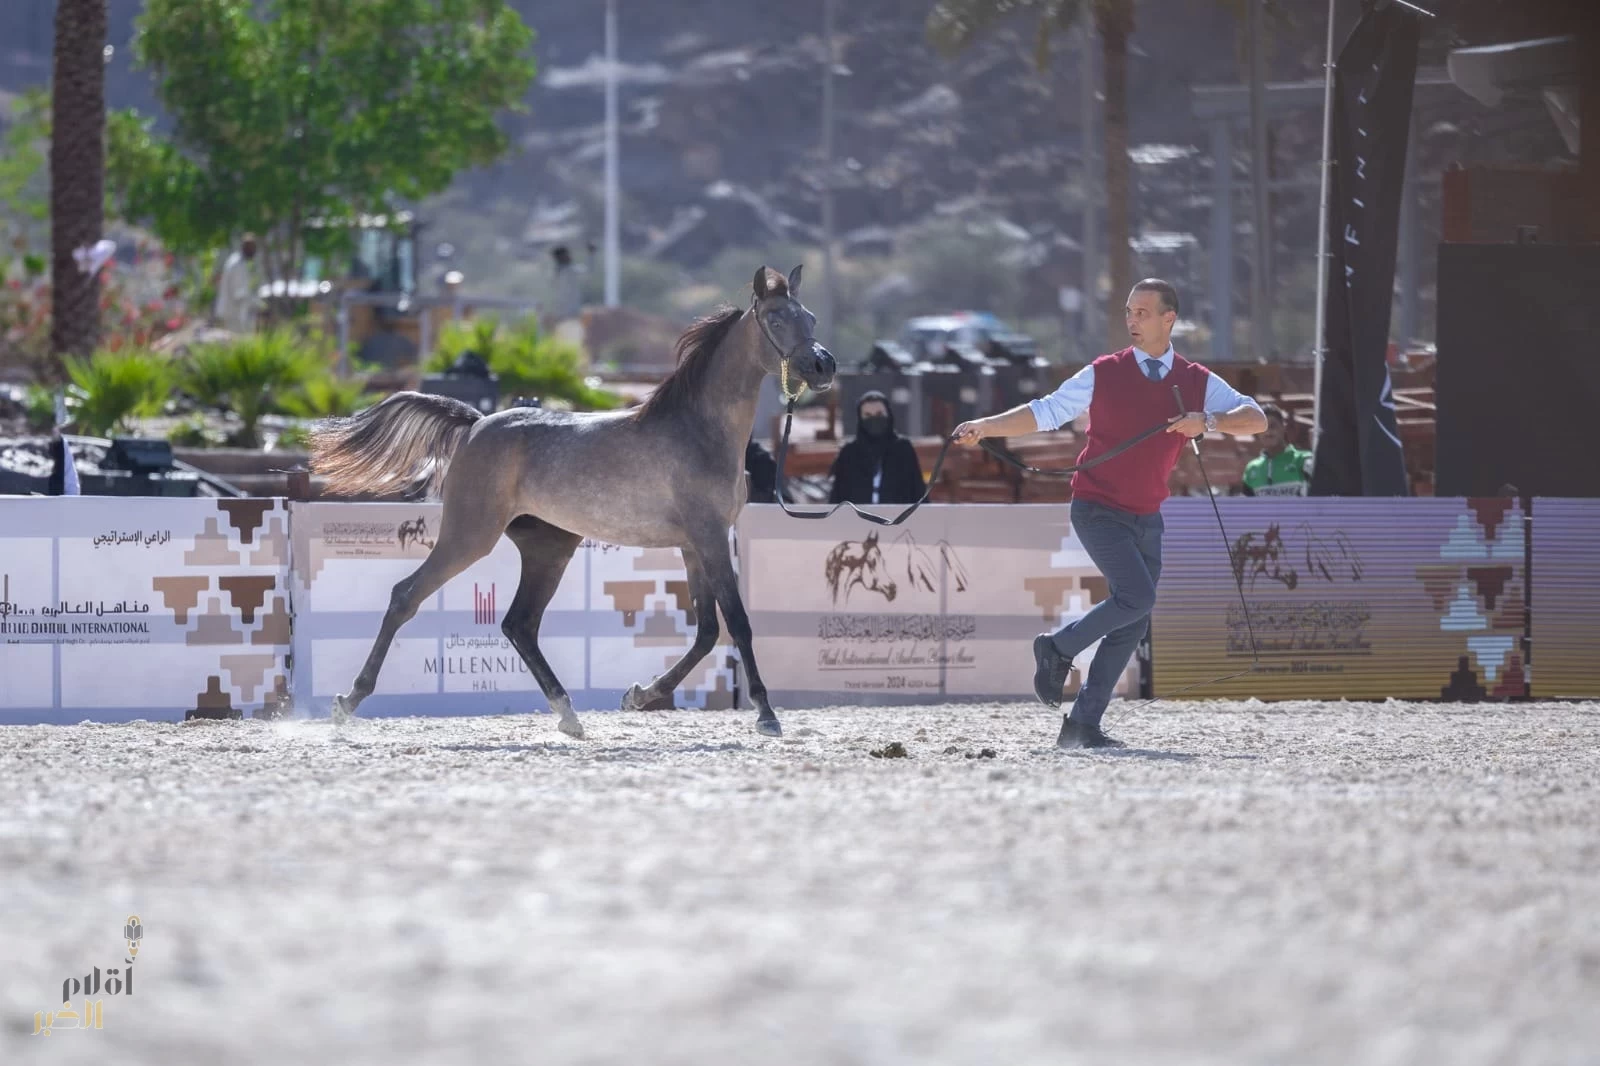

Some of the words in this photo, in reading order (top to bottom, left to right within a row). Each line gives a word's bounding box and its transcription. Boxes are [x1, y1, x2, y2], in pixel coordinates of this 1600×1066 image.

[144, 529, 170, 549] الراعي
[95, 600, 150, 617] مناهل
[71, 621, 150, 634] INTERNATIONAL
[423, 656, 529, 674] MILLENNIU
[472, 680, 499, 692] HAIL
[886, 675, 906, 689] 2024
